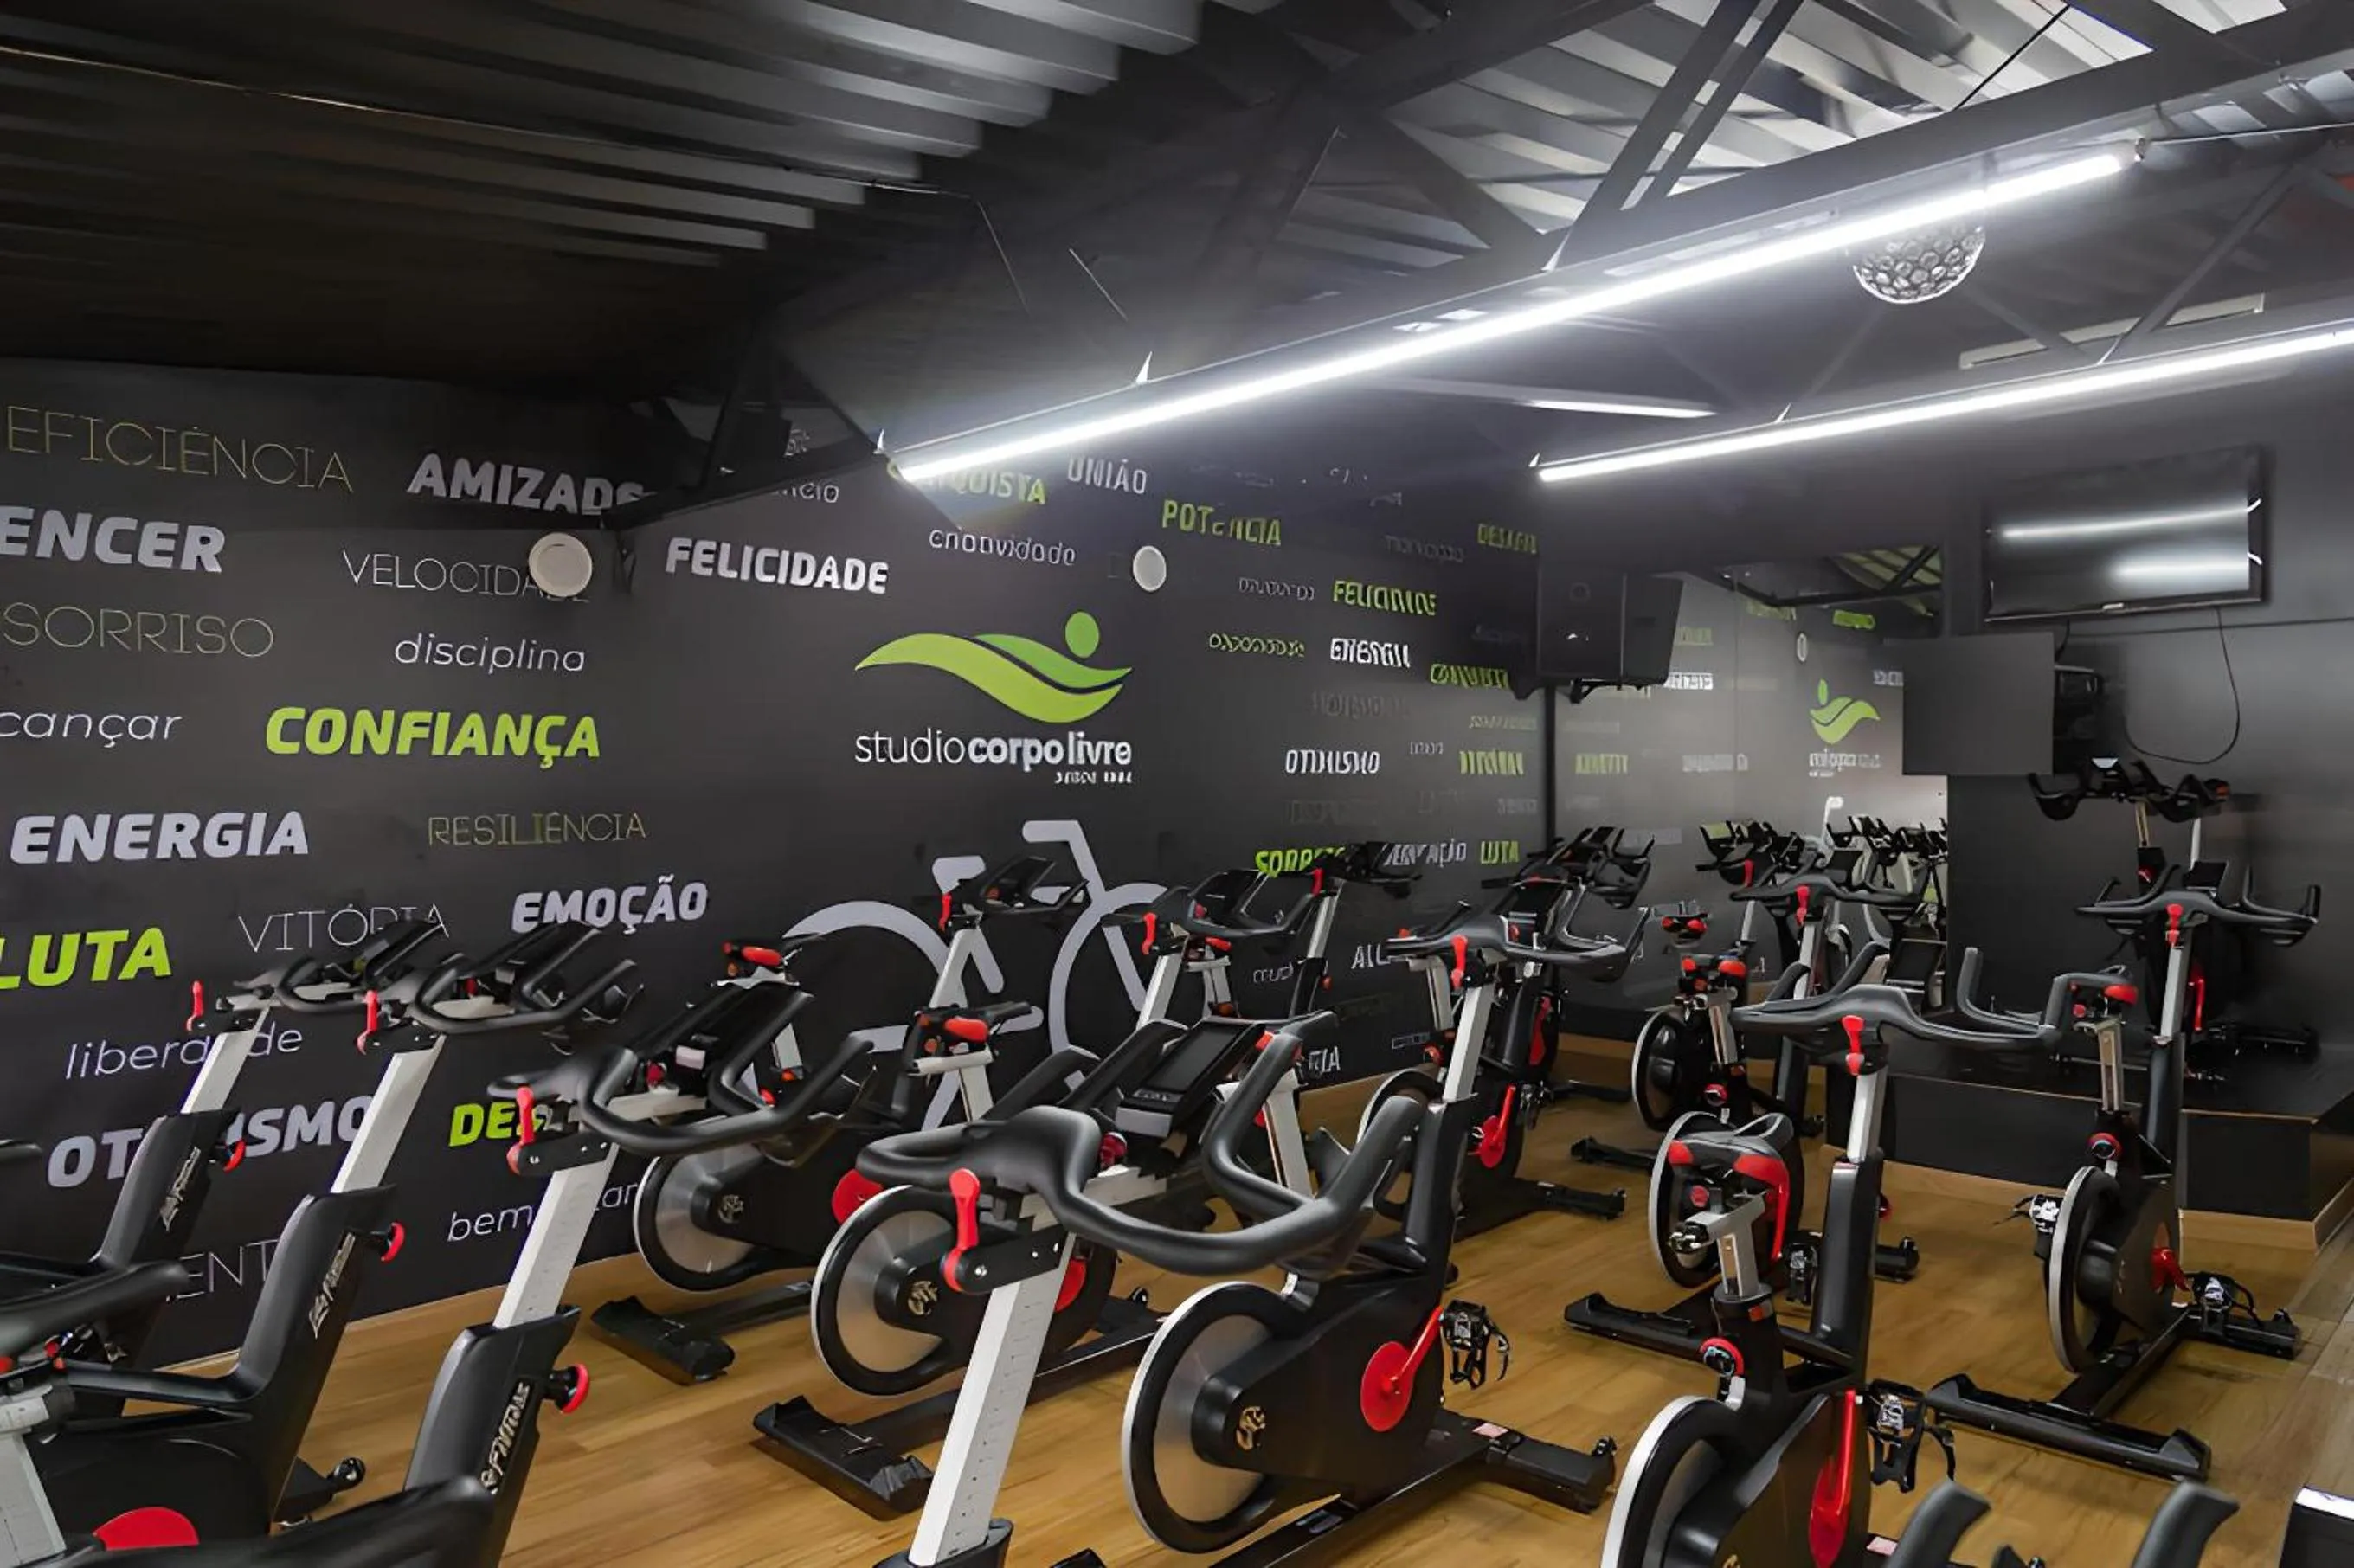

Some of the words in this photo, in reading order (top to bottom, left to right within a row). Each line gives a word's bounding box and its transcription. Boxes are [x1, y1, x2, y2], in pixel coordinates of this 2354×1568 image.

[7, 404, 353, 492] EFICIÊNCIA
[1067, 455, 1148, 495] UNIÃO
[342, 549, 591, 604] VELOCID
[665, 537, 890, 594] FELICIDADE
[3, 602, 274, 658] SORRISO
[394, 633, 586, 674] disciplina
[266, 707, 601, 768] CONFIANÇA
[10, 811, 309, 864] ENERGIA
[428, 813, 648, 847] RESILIÊNCIA
[511, 874, 708, 935] EMOÇÃO
[0, 927, 172, 989] LUTA
[65, 1020, 304, 1081] liberdde
[48, 1095, 375, 1188] OTISMO
